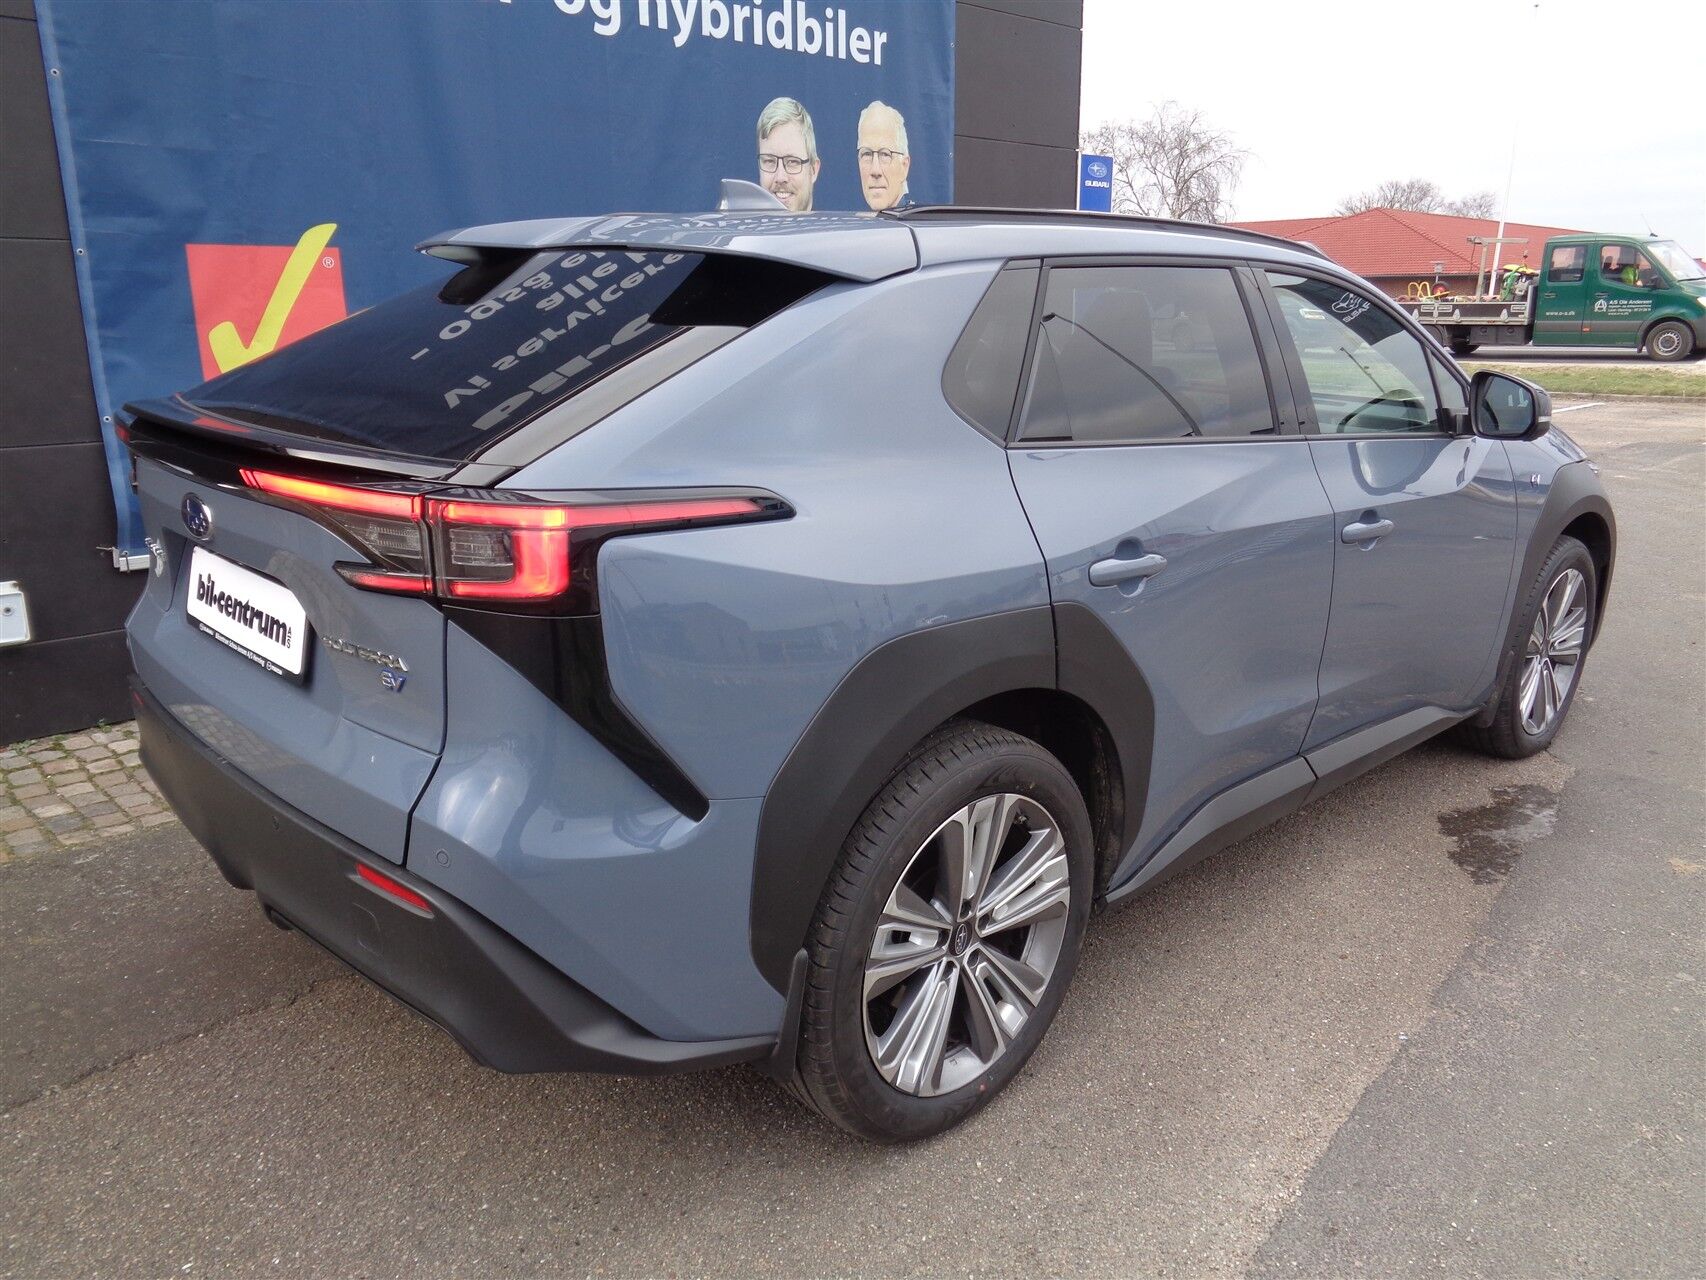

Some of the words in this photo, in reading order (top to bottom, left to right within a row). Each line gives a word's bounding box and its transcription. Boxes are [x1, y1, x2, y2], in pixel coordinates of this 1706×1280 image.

[638, 0, 888, 66] hybridbiler
[1085, 180, 1110, 189] SUBARU
[381, 668, 407, 693] EV
